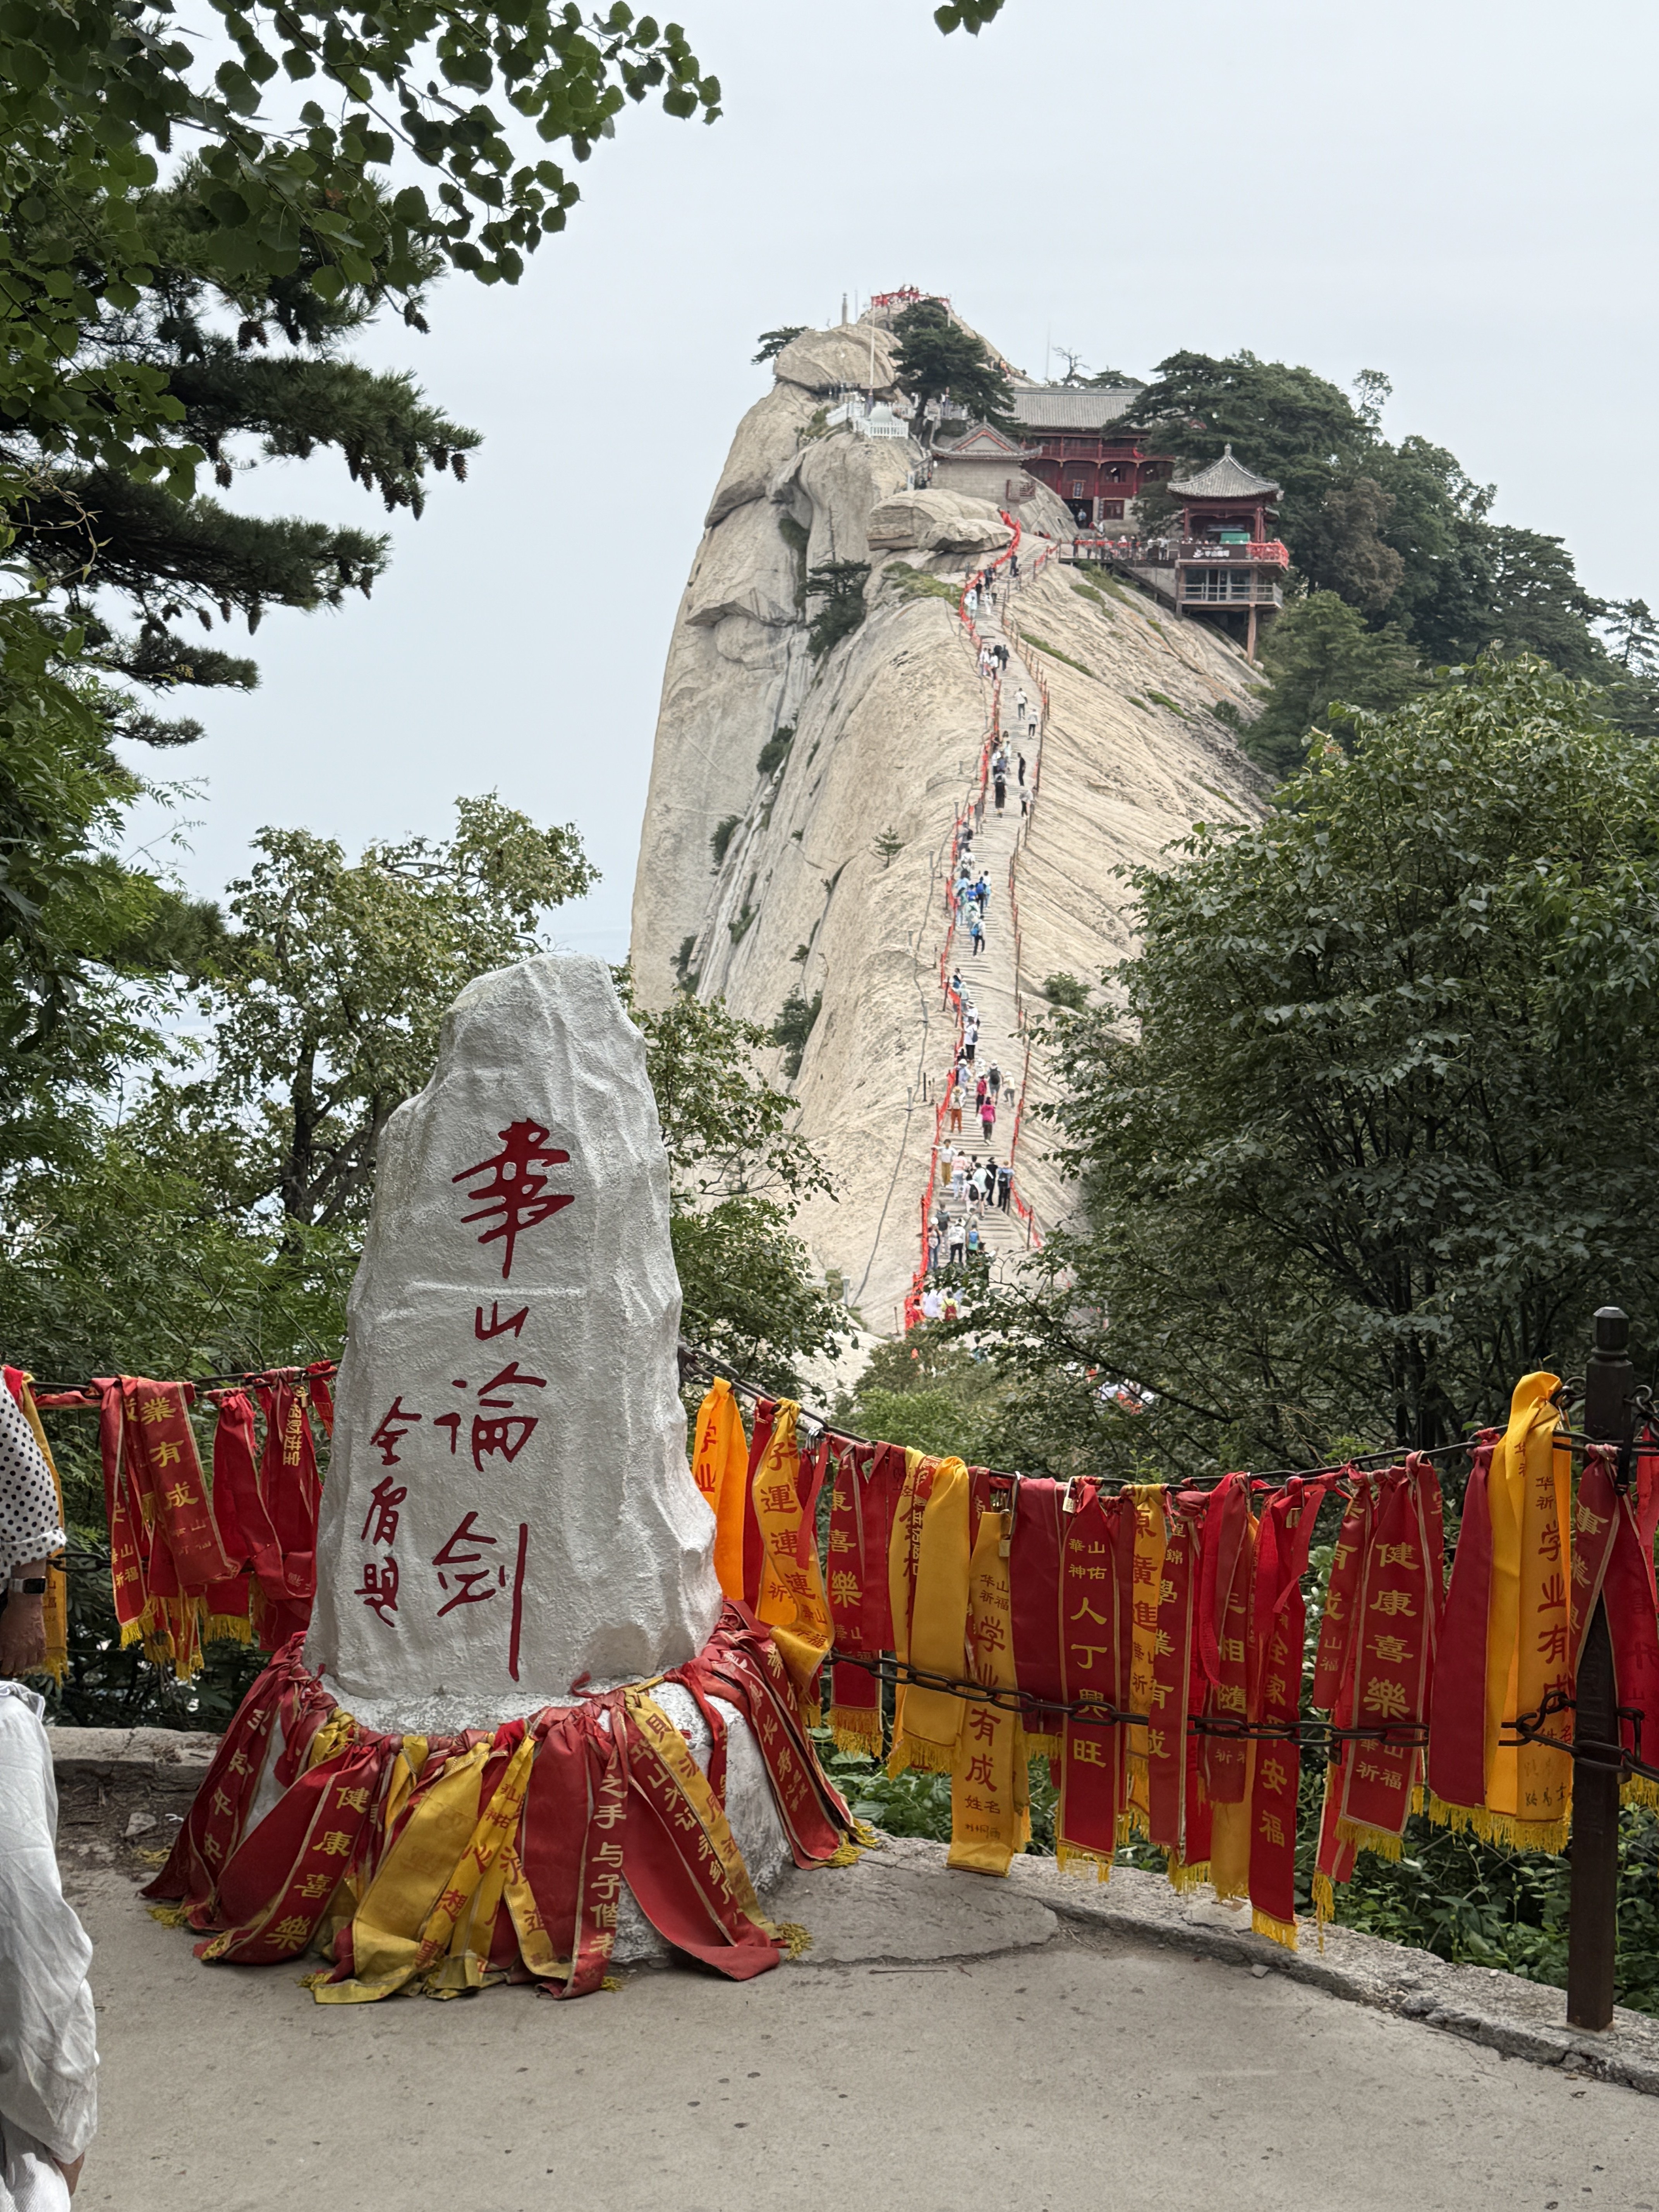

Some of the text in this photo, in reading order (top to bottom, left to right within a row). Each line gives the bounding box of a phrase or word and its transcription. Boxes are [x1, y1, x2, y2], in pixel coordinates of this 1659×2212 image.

[1069, 1538, 1105, 1554] 華山
[980, 1574, 1010, 1593] 华山
[1068, 1563, 1107, 1579] 神佑
[979, 1590, 1009, 1611] 祈福
[1364, 1542, 1420, 1721] 健康喜樂
[1070, 1597, 1108, 1768] 人丁興旺
[965, 1615, 1006, 1792] 学业有成
[1356, 1761, 1403, 1790] 祈福
[965, 1794, 1001, 1815] 姓名
[264, 1786, 371, 1951] 健康喜樂
